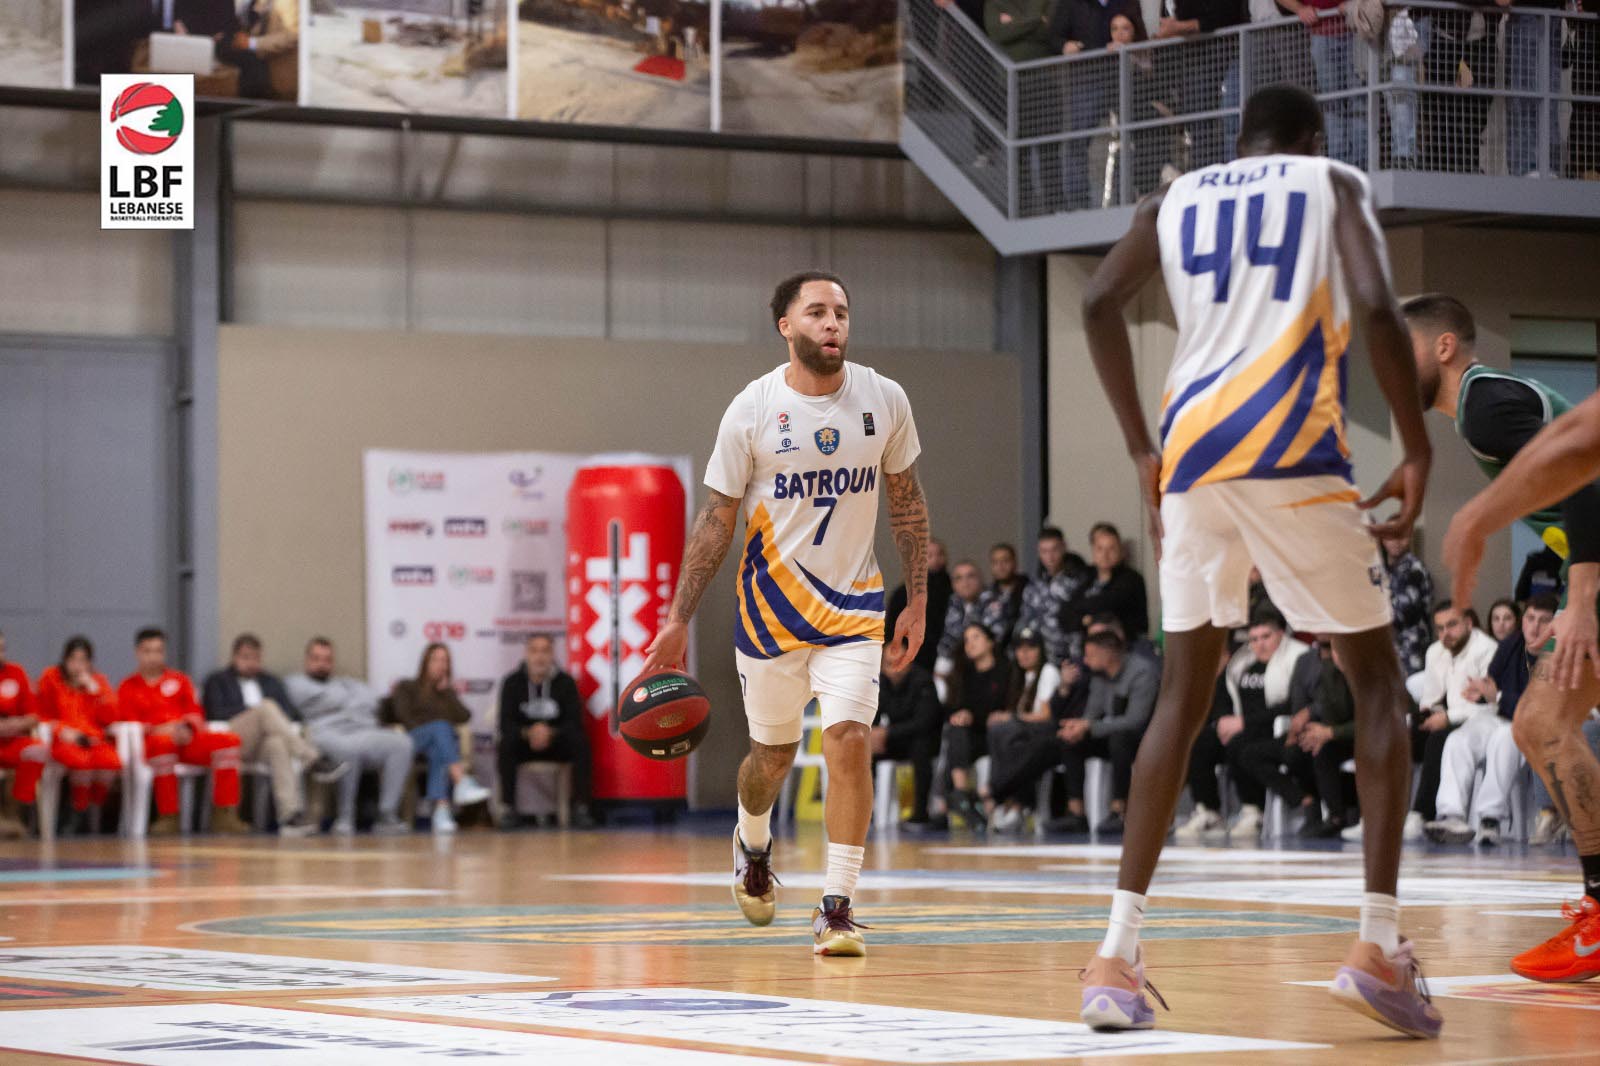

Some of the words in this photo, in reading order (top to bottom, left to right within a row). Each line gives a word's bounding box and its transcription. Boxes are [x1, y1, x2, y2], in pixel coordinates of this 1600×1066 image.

[1181, 191, 1307, 303] 44
[773, 465, 878, 499] BATROUN
[812, 497, 838, 546] 7
[1240, 672, 1265, 689] BOS
